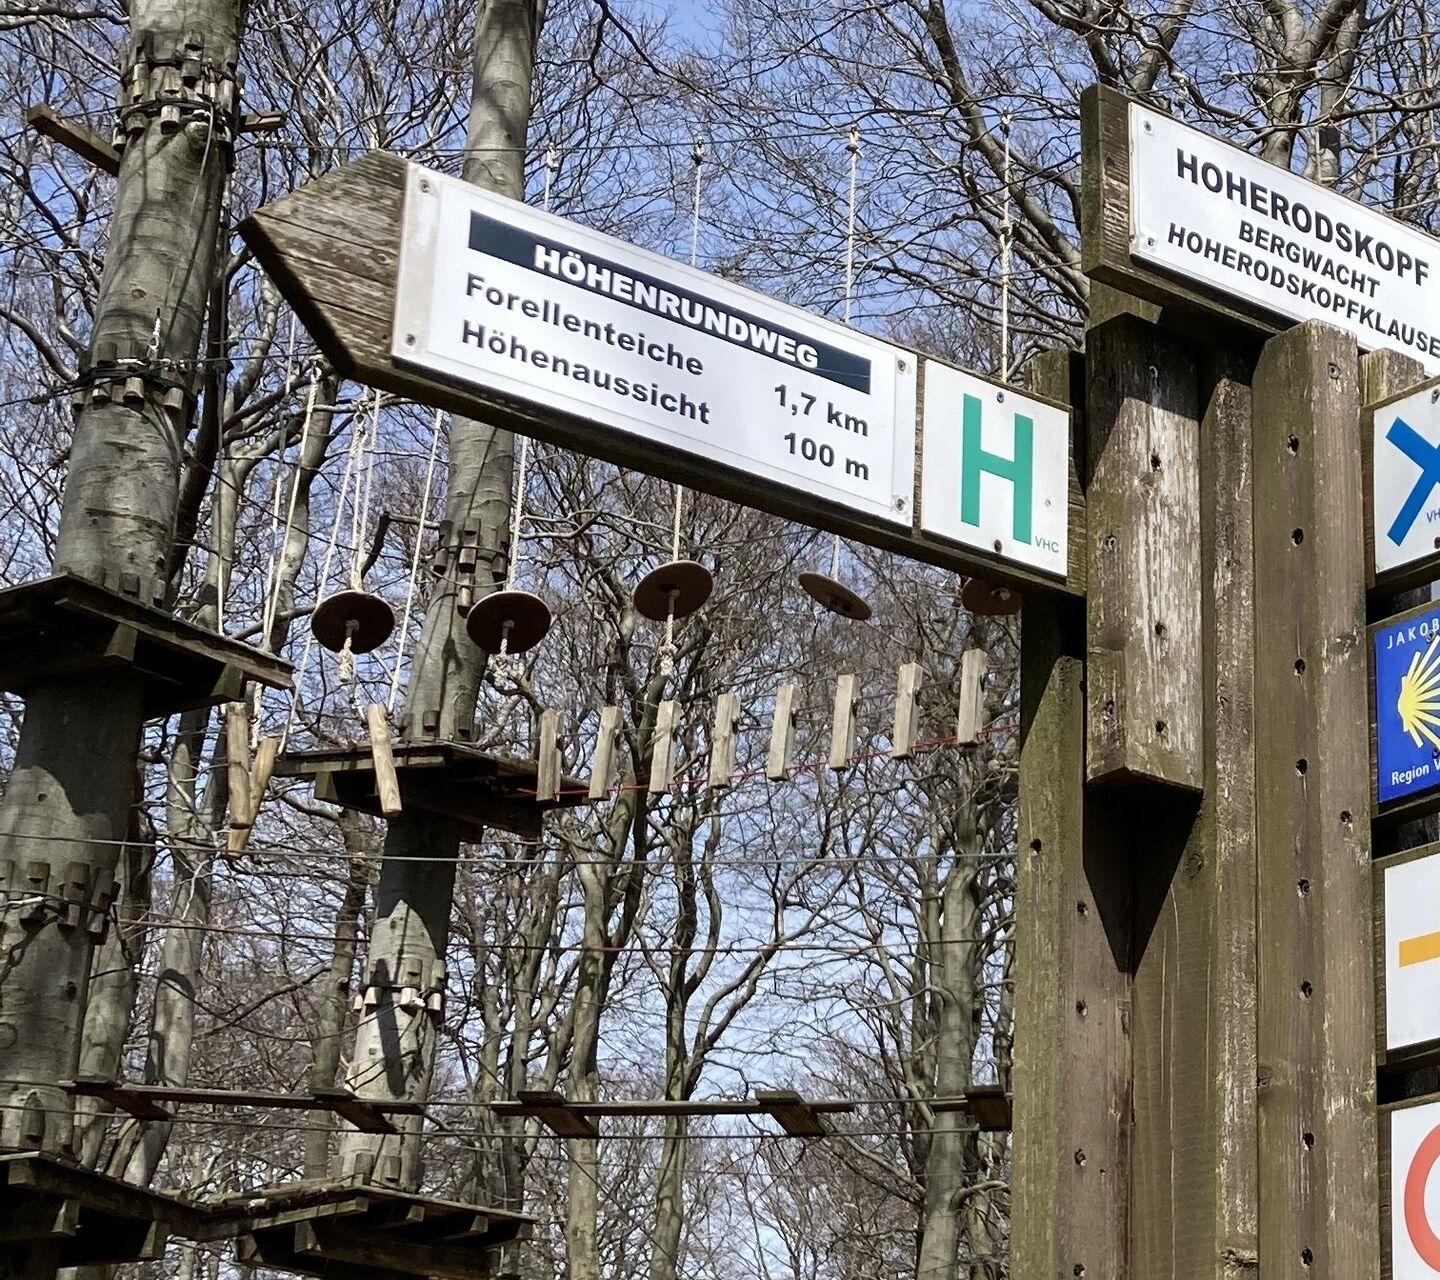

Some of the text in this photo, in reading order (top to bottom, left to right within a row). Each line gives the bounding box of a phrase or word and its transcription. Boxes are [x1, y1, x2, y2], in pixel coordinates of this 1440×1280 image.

[1177, 148, 1428, 287] HOHERODSKOPF
[1239, 220, 1380, 298] BERGWACHT
[466, 273, 869, 437] Forellenteiche 1,7 km
[533, 243, 820, 369] HÖHENRUNDWEG
[1168, 222, 1440, 358] HOHERODSKOPFKLAUSE
[462, 320, 869, 481] Höhenaussicht 100 m
[1035, 536, 1060, 554] VHC
[1391, 764, 1430, 786] Region
